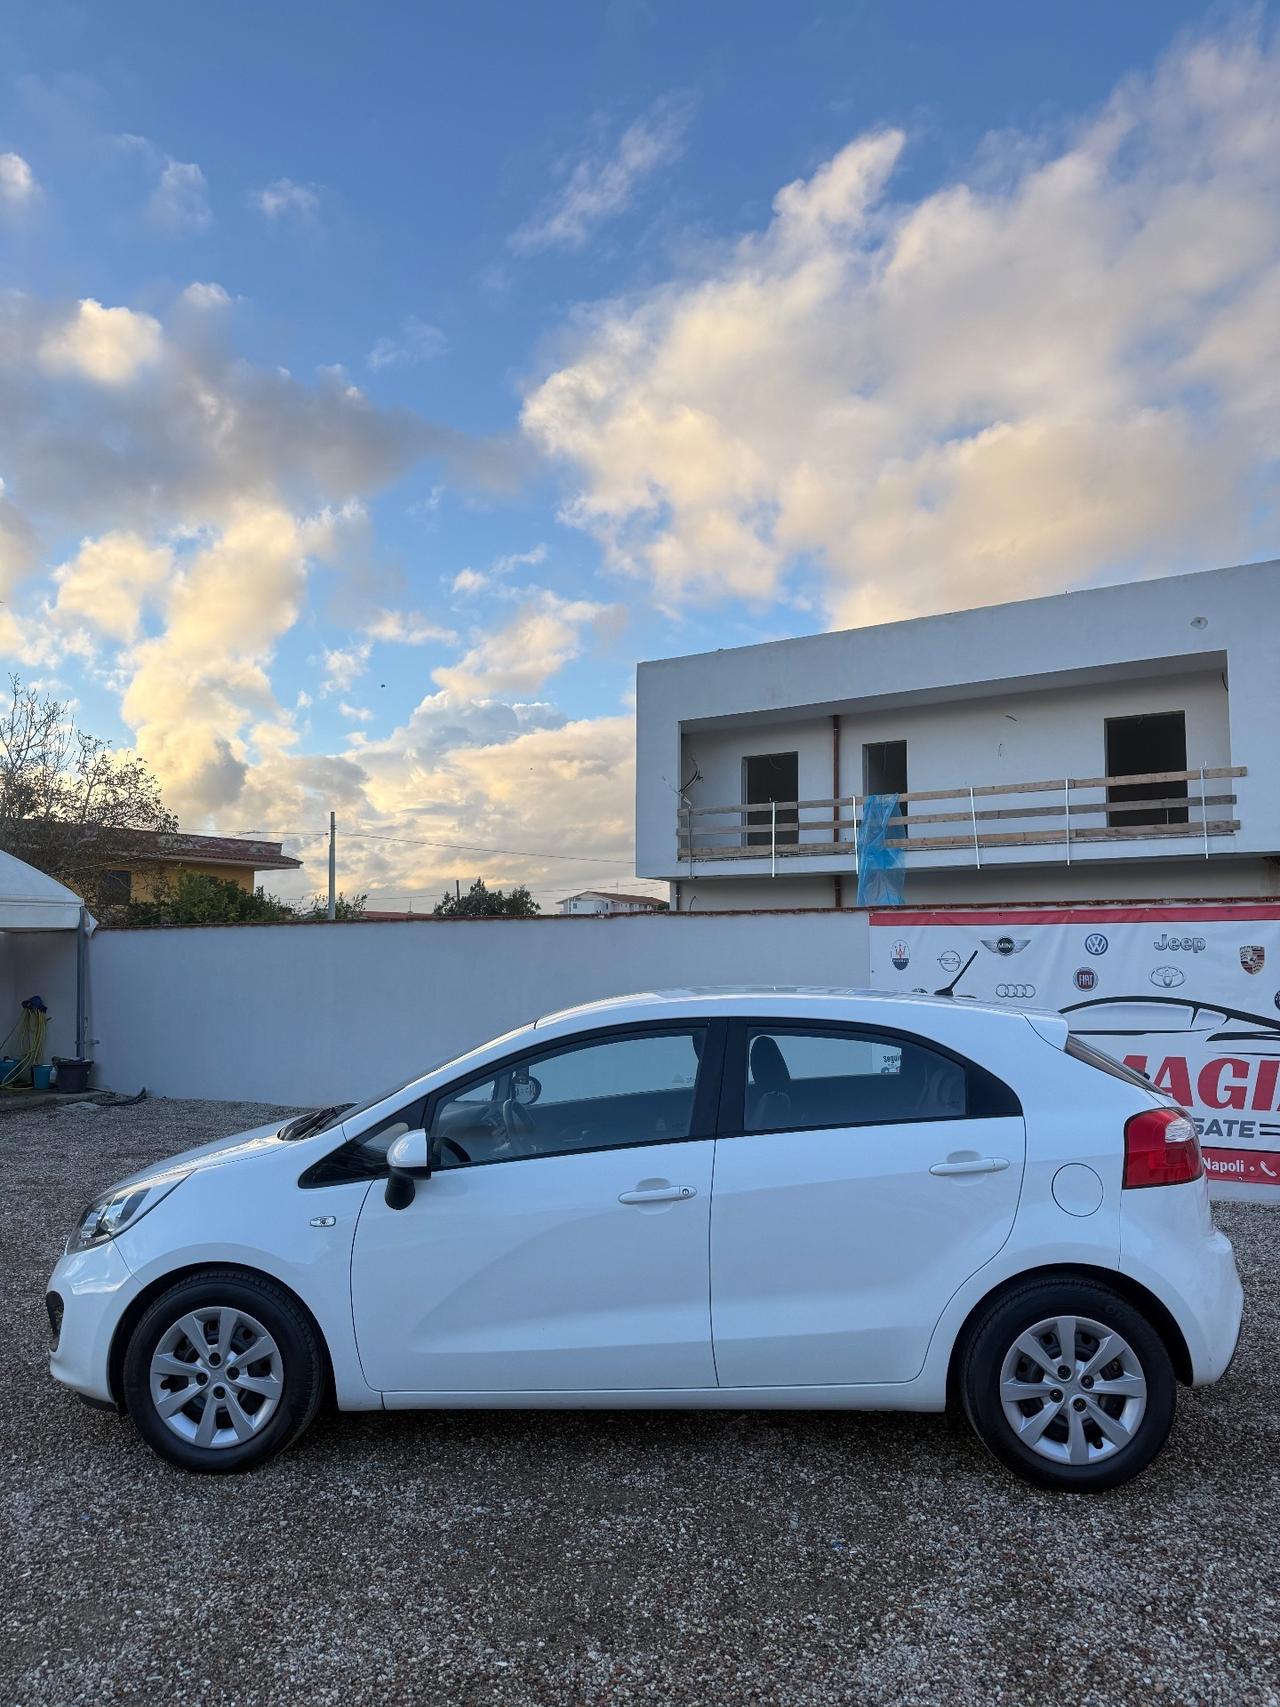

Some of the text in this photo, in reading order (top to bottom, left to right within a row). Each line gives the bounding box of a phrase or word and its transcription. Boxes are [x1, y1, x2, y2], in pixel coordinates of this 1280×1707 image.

[1153, 934, 1206, 953] Jeep
[1079, 974, 1094, 986] FIAT
[1122, 1055, 1280, 1112] AGI
[1202, 1157, 1244, 1174] Napoli
